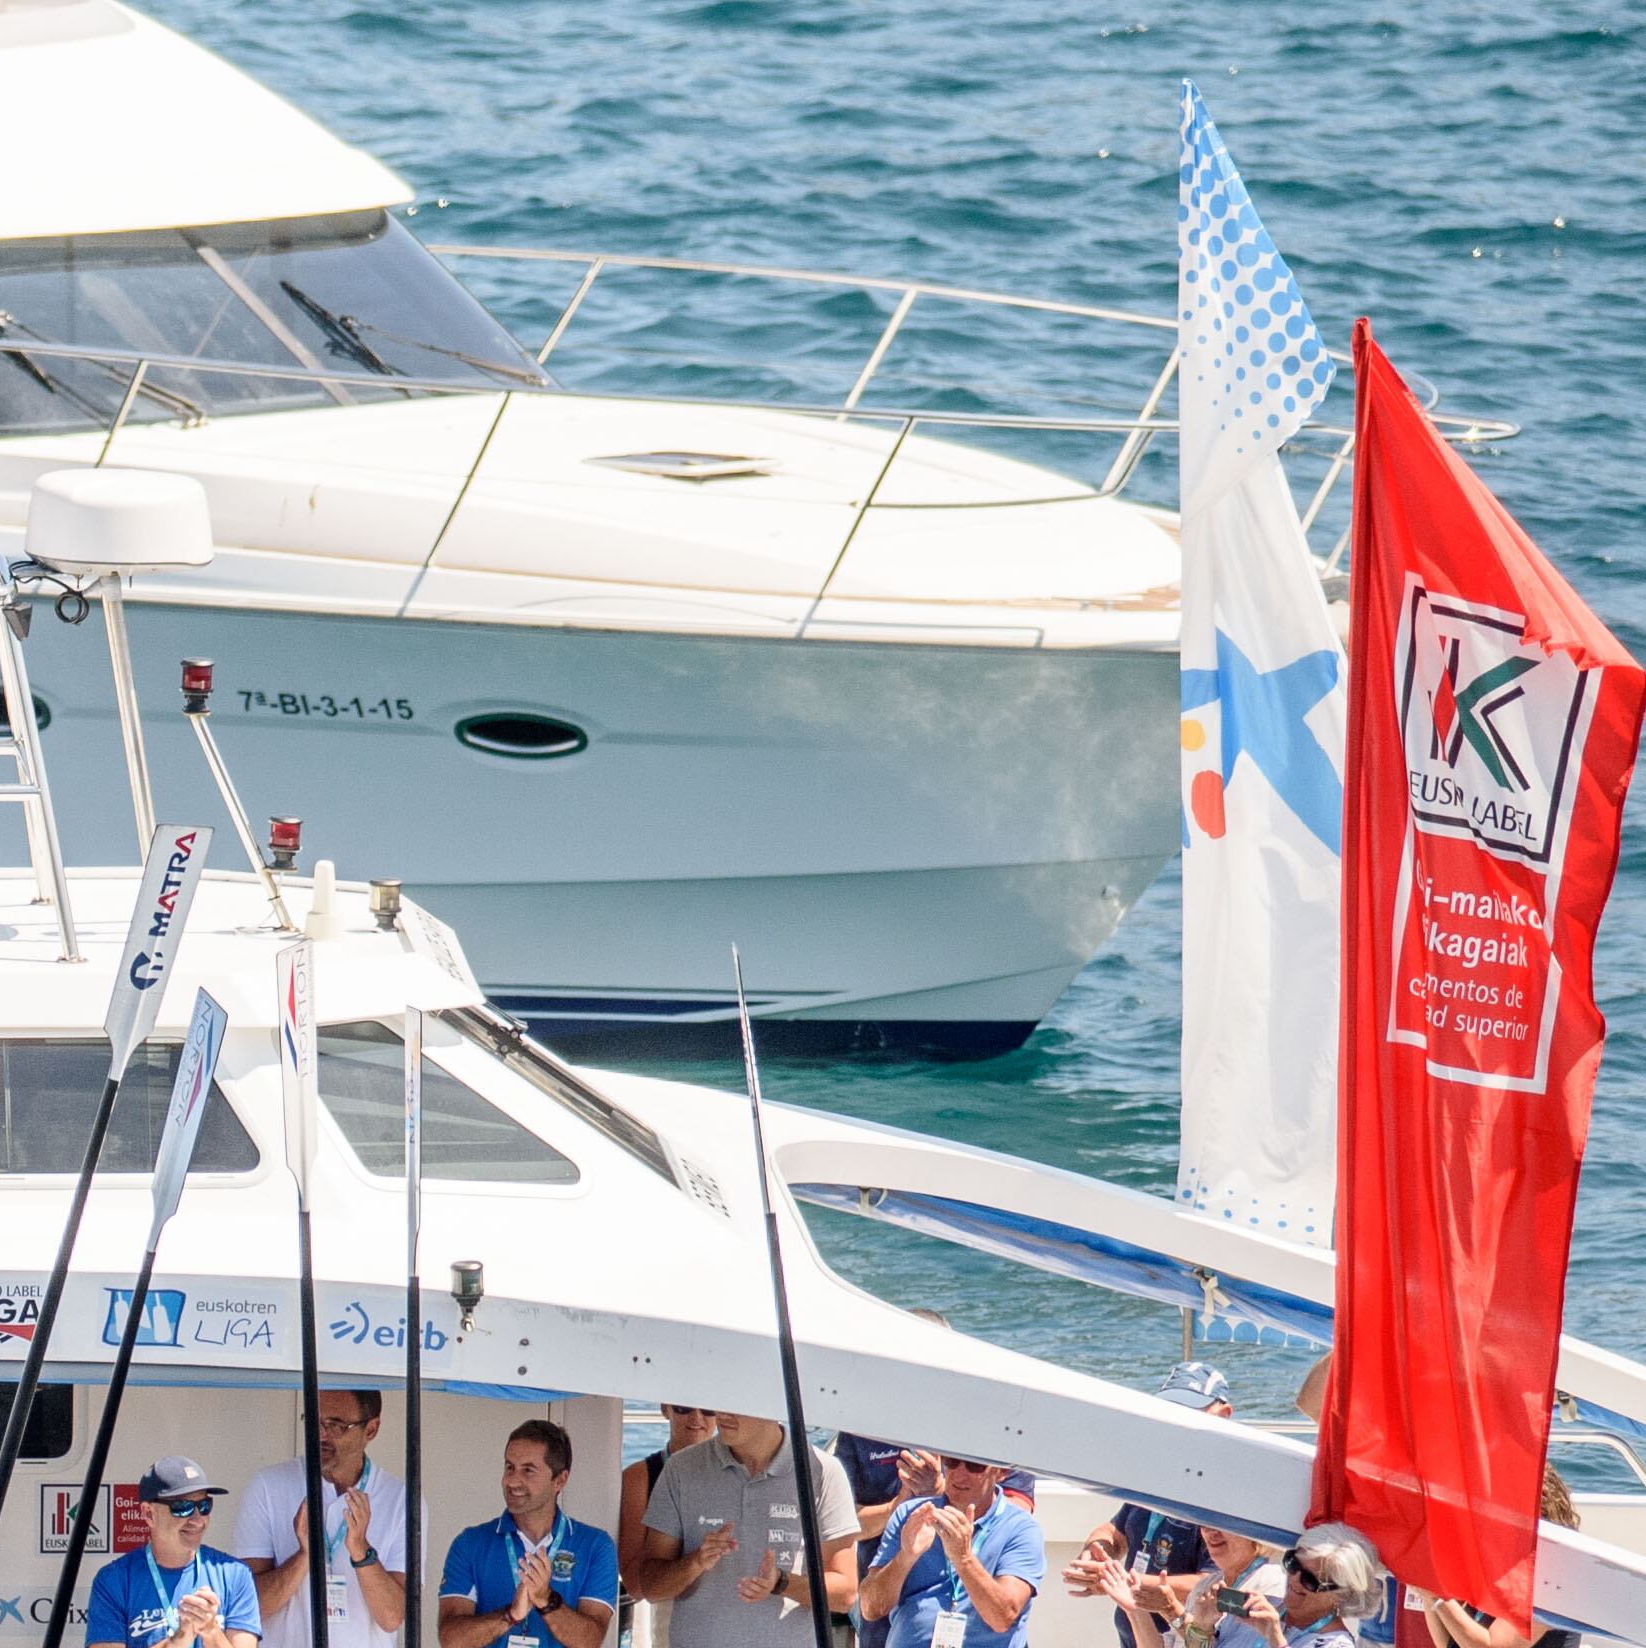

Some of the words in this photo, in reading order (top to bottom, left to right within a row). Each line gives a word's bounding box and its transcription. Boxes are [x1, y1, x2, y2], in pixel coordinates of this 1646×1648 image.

[1410, 772, 1465, 808] EUSK
[147, 831, 197, 937] MATRA
[1505, 988, 1523, 1009] de
[1455, 1010, 1529, 1046] superior
[175, 1003, 212, 1127] NORTON
[6, 1285, 43, 1298] LABEL
[195, 1299, 277, 1315] euskotren
[195, 1318, 273, 1348] LIGA
[373, 1317, 446, 1351] eib
[45, 1538, 69, 1550] EUSK
[85, 1538, 105, 1550] ABEL
